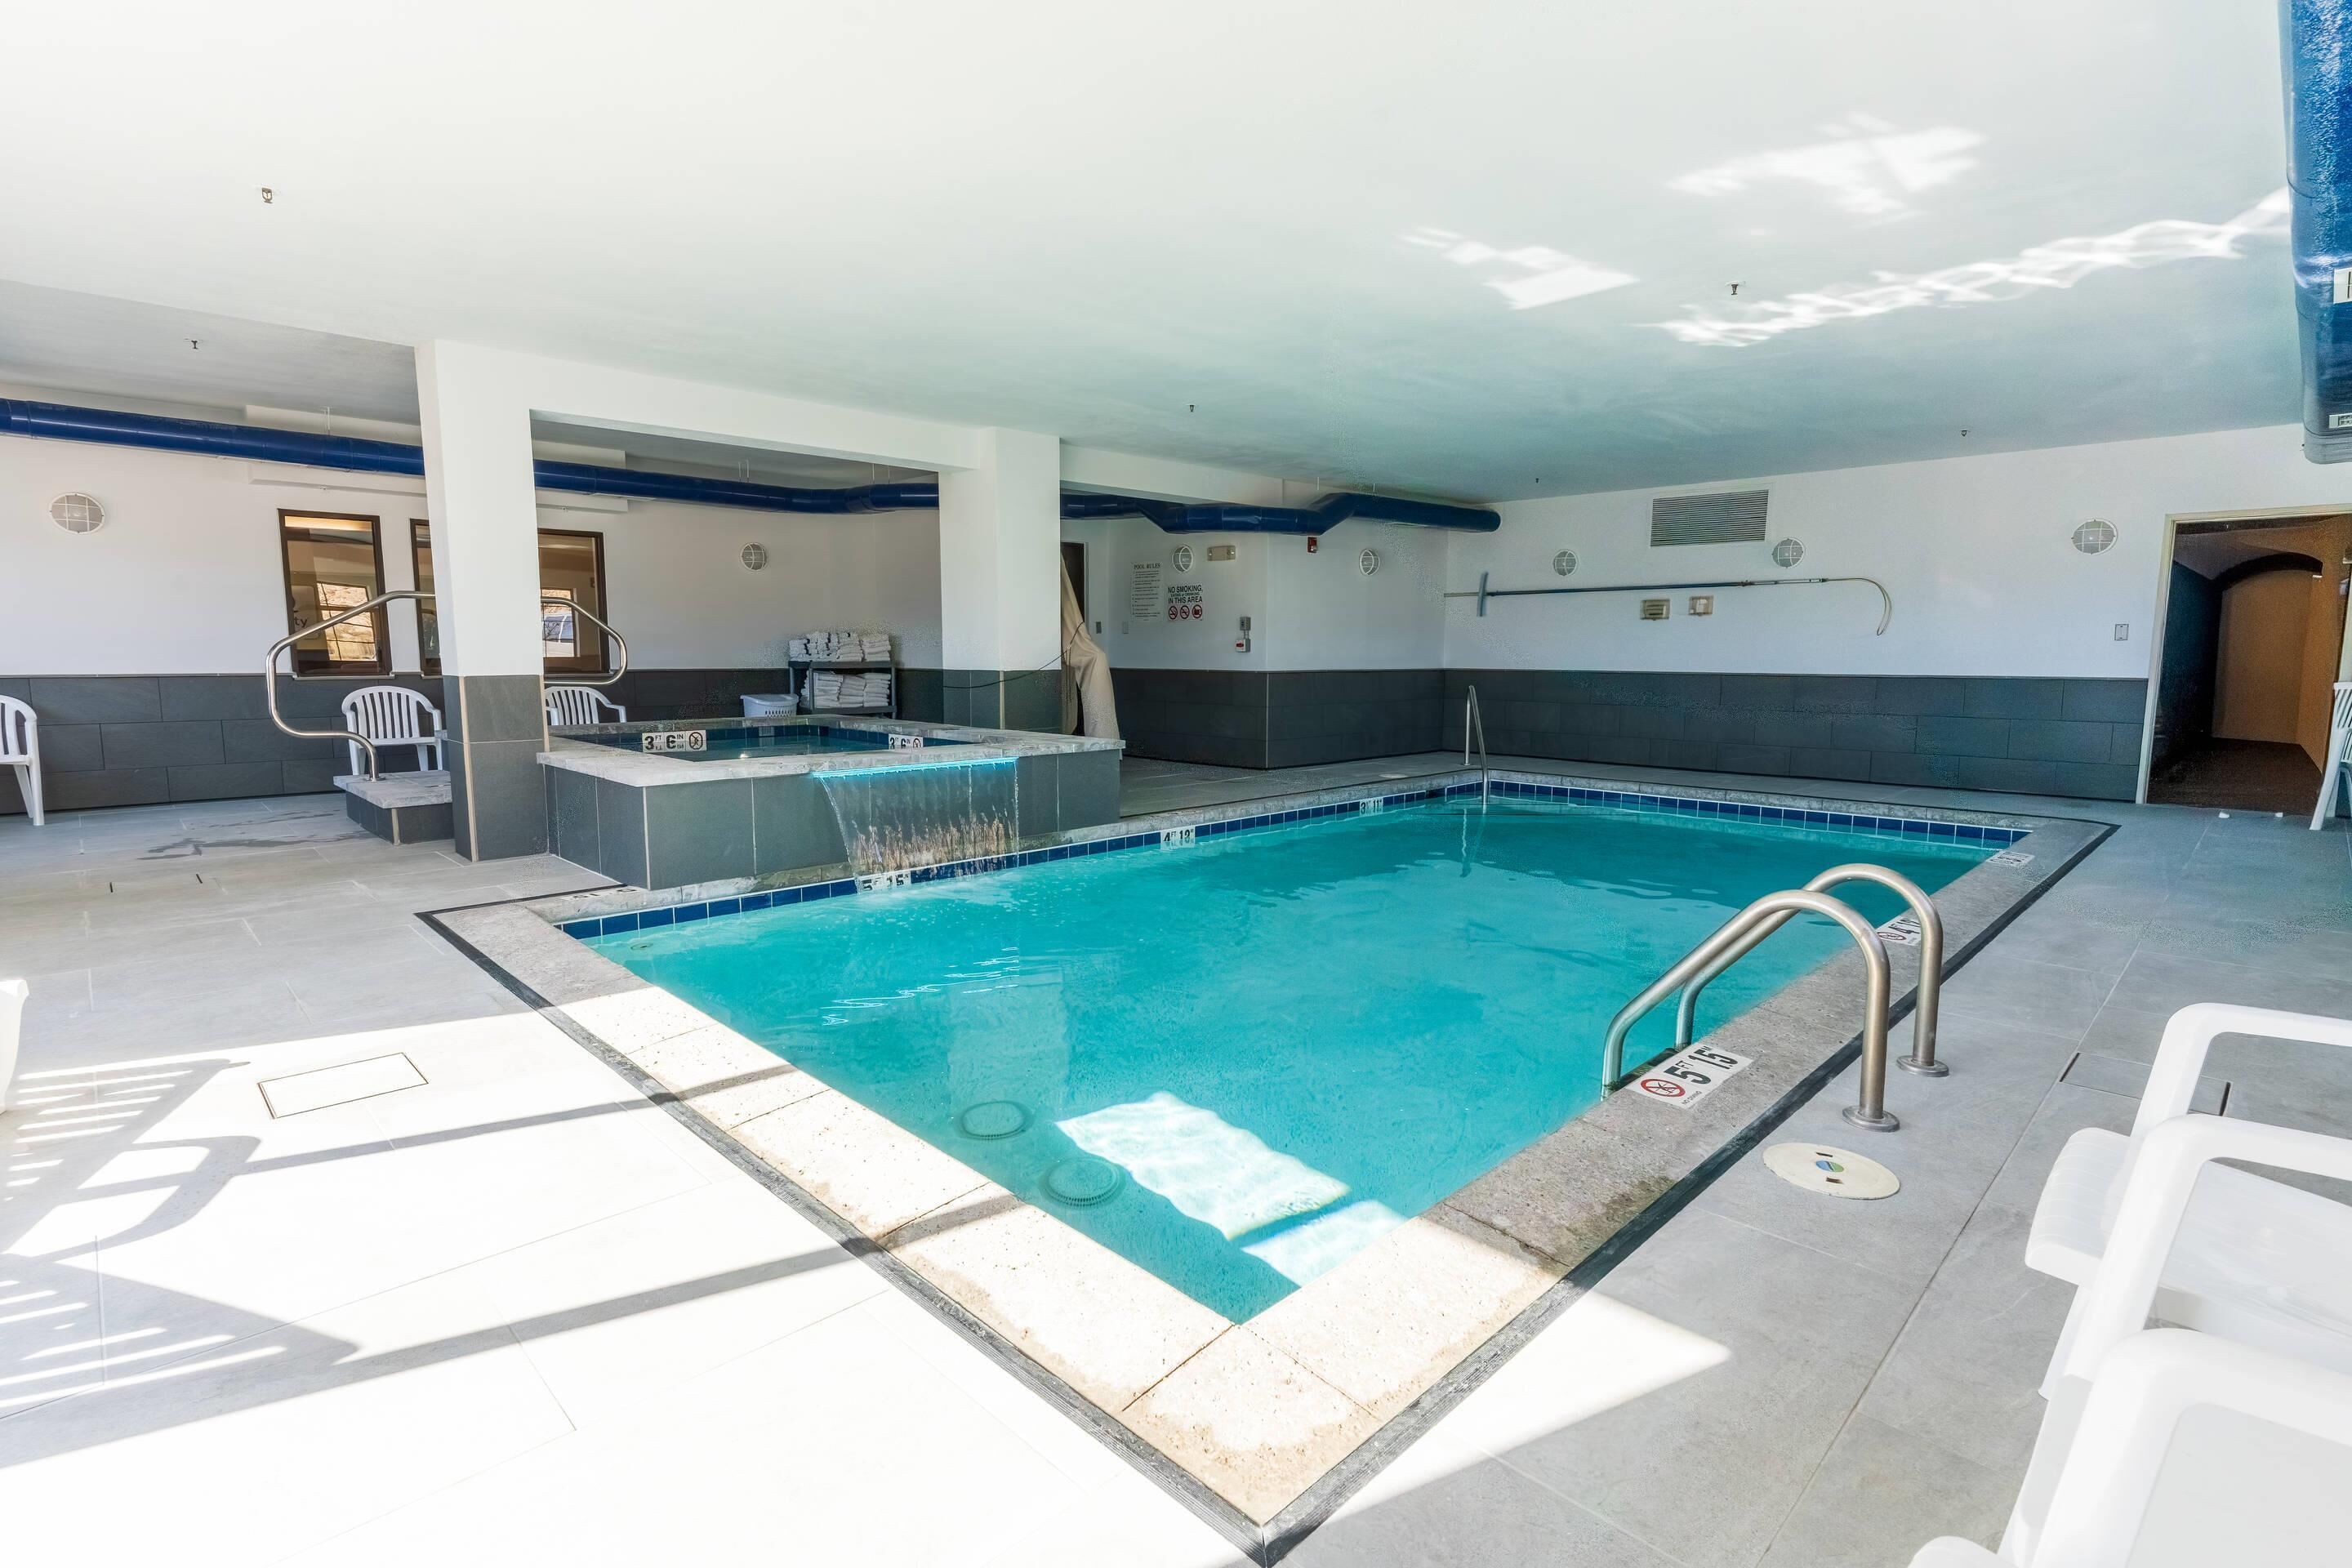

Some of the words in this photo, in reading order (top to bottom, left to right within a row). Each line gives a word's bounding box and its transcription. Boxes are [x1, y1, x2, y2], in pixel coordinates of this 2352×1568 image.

[1187, 595, 1203, 604] AREA
[1674, 1060, 1694, 1069] FT
[1664, 1066, 1711, 1085] 5
